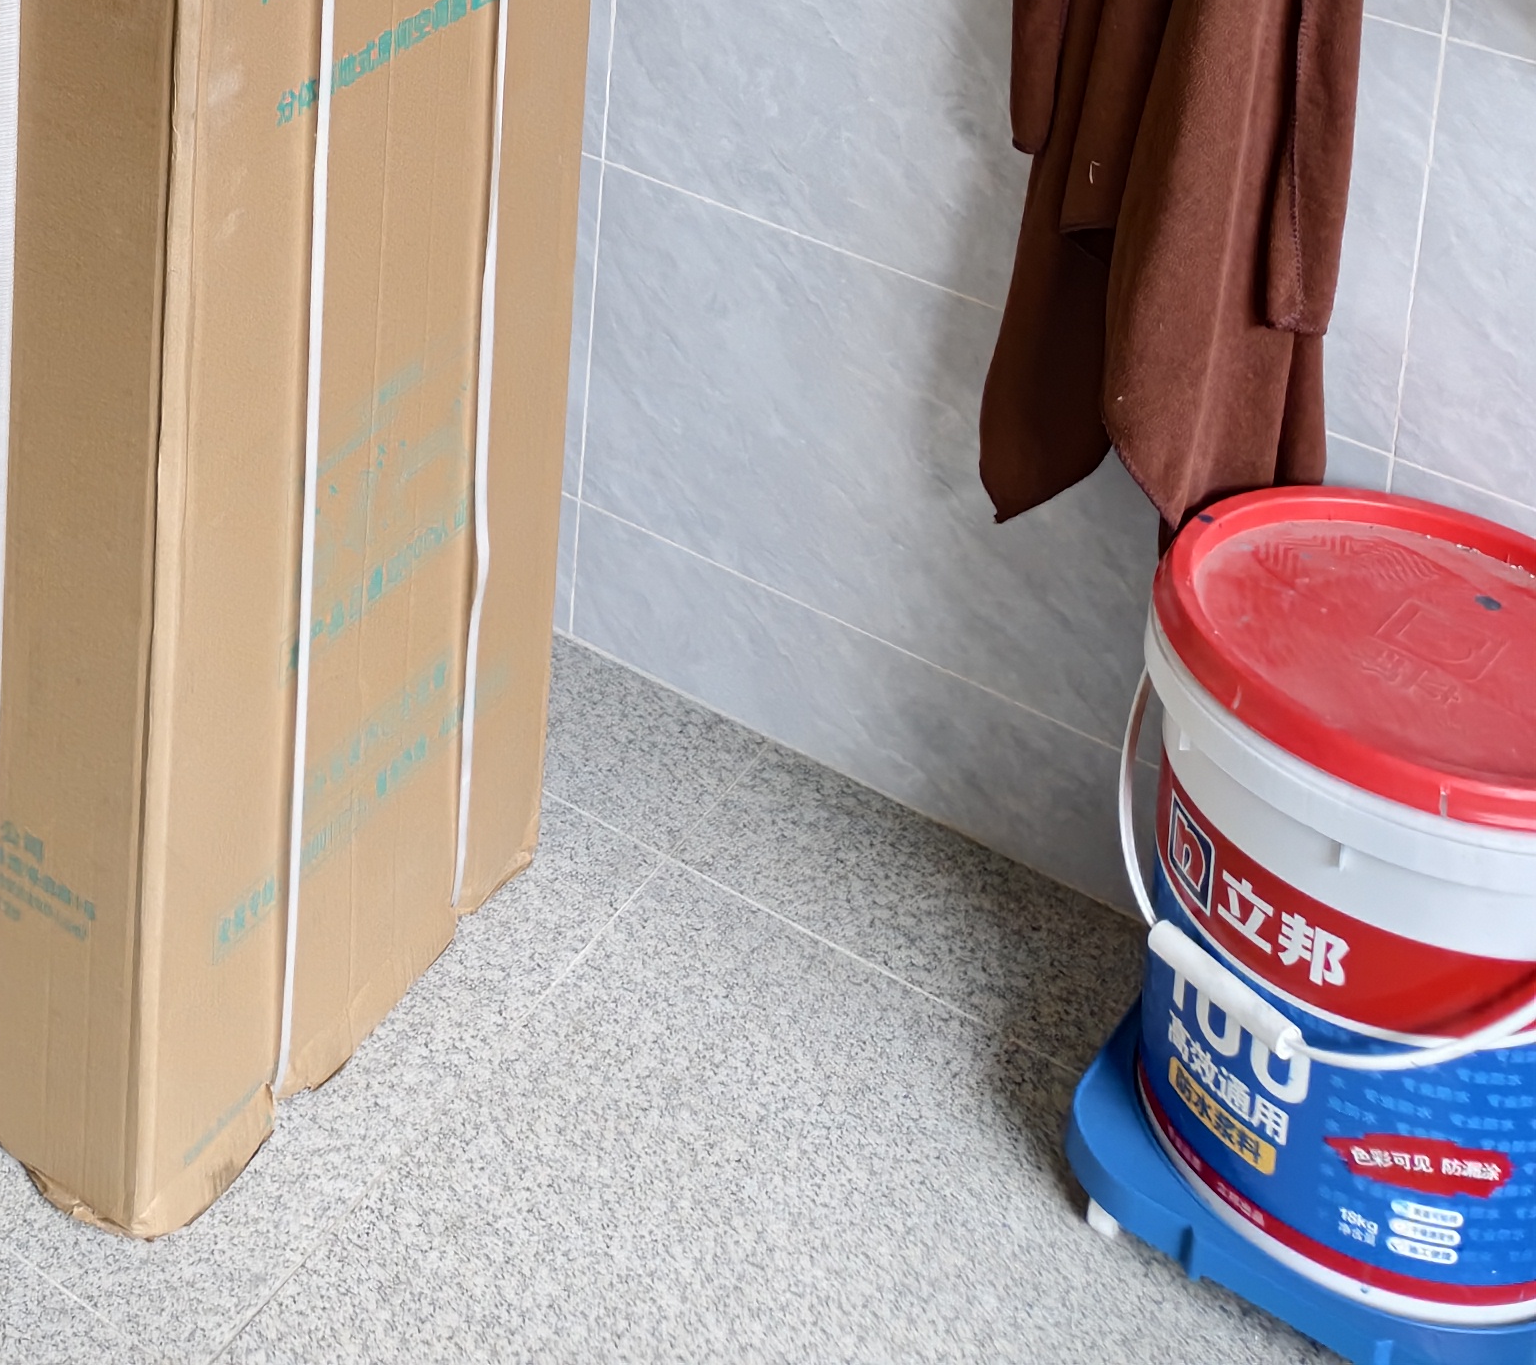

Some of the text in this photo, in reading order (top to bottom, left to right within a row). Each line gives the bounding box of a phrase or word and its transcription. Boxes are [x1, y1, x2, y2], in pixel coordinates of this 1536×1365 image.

[1217, 869, 1351, 987] 立邦
[1168, 1008, 1290, 1146] 高效通用
[1350, 1144, 1434, 1174] 色彩可见
